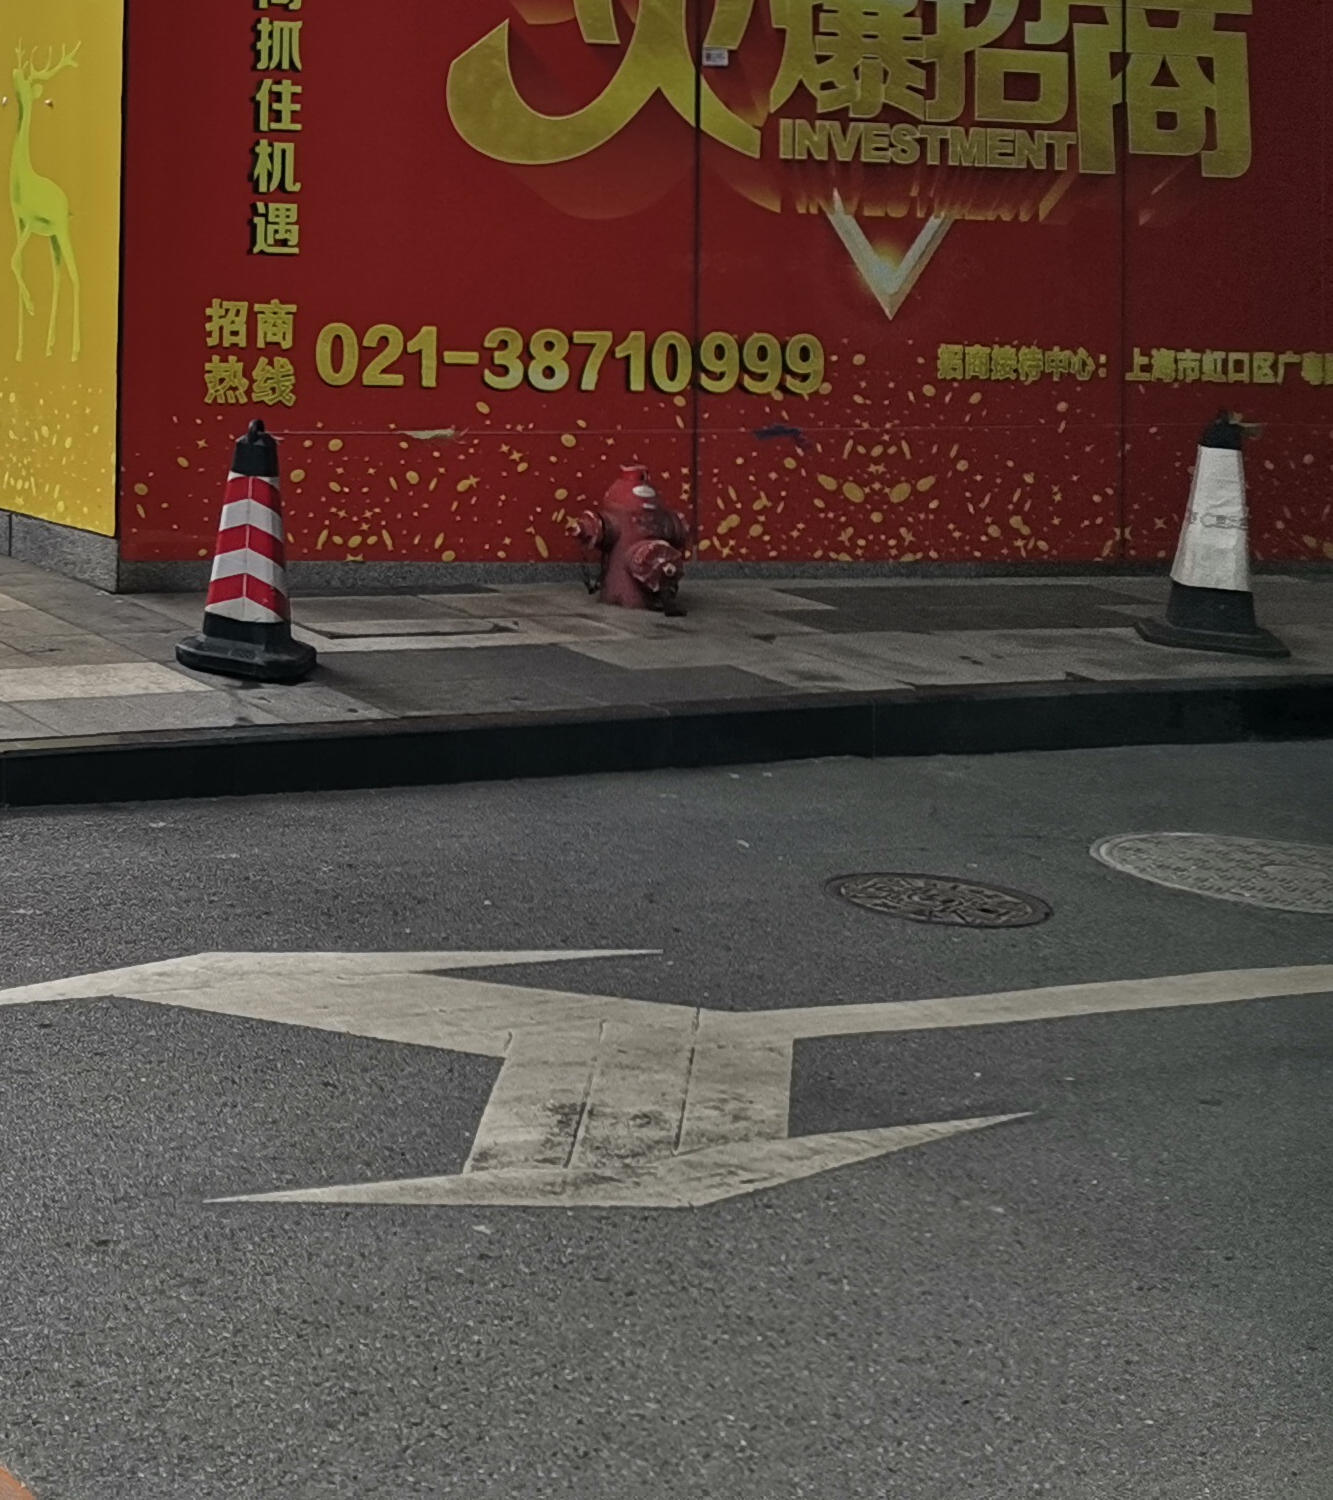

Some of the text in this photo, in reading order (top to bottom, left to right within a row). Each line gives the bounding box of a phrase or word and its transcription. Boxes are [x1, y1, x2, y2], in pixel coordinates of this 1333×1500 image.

[779, 117, 1076, 170] INVESTMENT
[205, 298, 297, 349] 招商
[204, 356, 297, 406] 热线
[315, 323, 825, 393] 021-38710999
